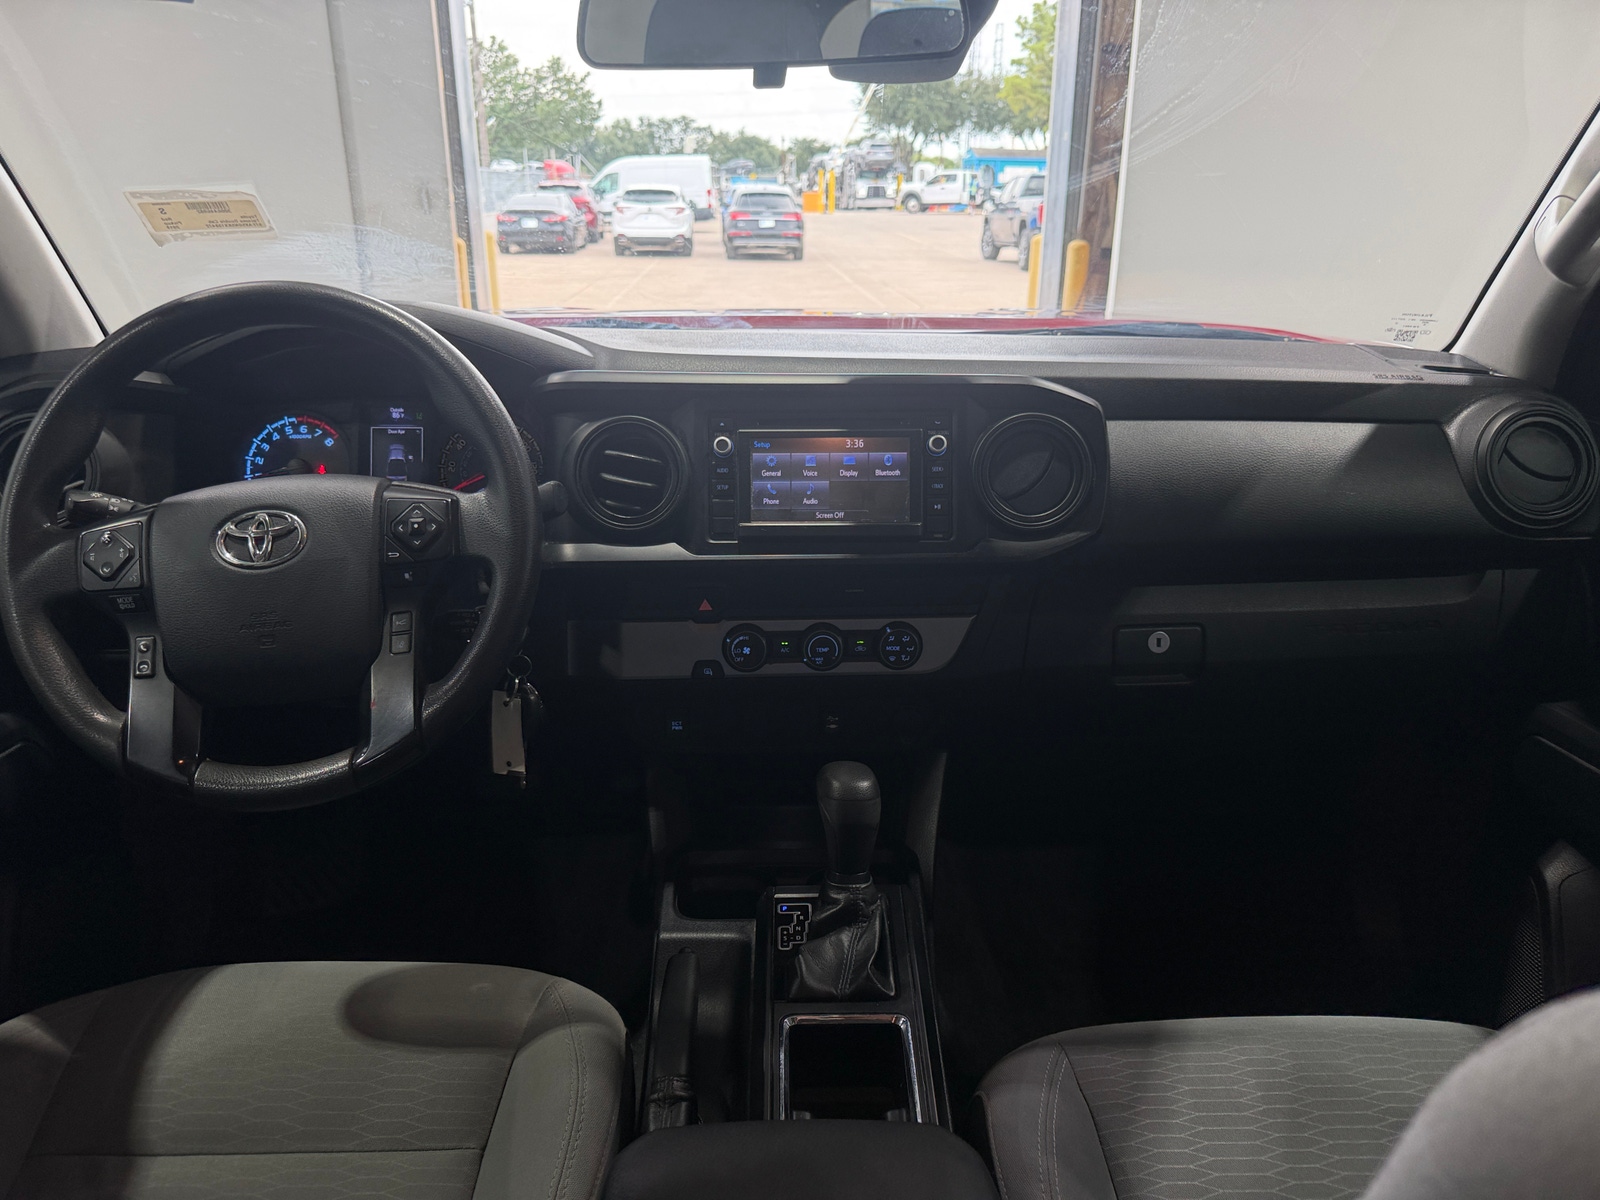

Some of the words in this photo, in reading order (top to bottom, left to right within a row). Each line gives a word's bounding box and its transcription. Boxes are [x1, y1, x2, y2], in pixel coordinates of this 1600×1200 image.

[285, 426, 293, 435] 5
[300, 425, 308, 433] 6
[314, 428, 323, 437] 7
[272, 432, 280, 441] 4
[324, 437, 334, 447] 8
[456, 439, 466, 450] 40
[753, 441, 771, 449] Setup
[845, 439, 864, 448] 3:36
[261, 442, 270, 452] 3
[255, 456, 264, 465] 2
[448, 461, 456, 472] 20
[761, 469, 782, 477] General
[802, 469, 818, 477] Voice
[839, 469, 859, 478] Display
[875, 469, 901, 477] Bluetooth
[762, 497, 780, 505] Phone
[802, 497, 818, 505] Audio
[815, 511, 833, 519] Screen
[834, 511, 845, 519] Off
